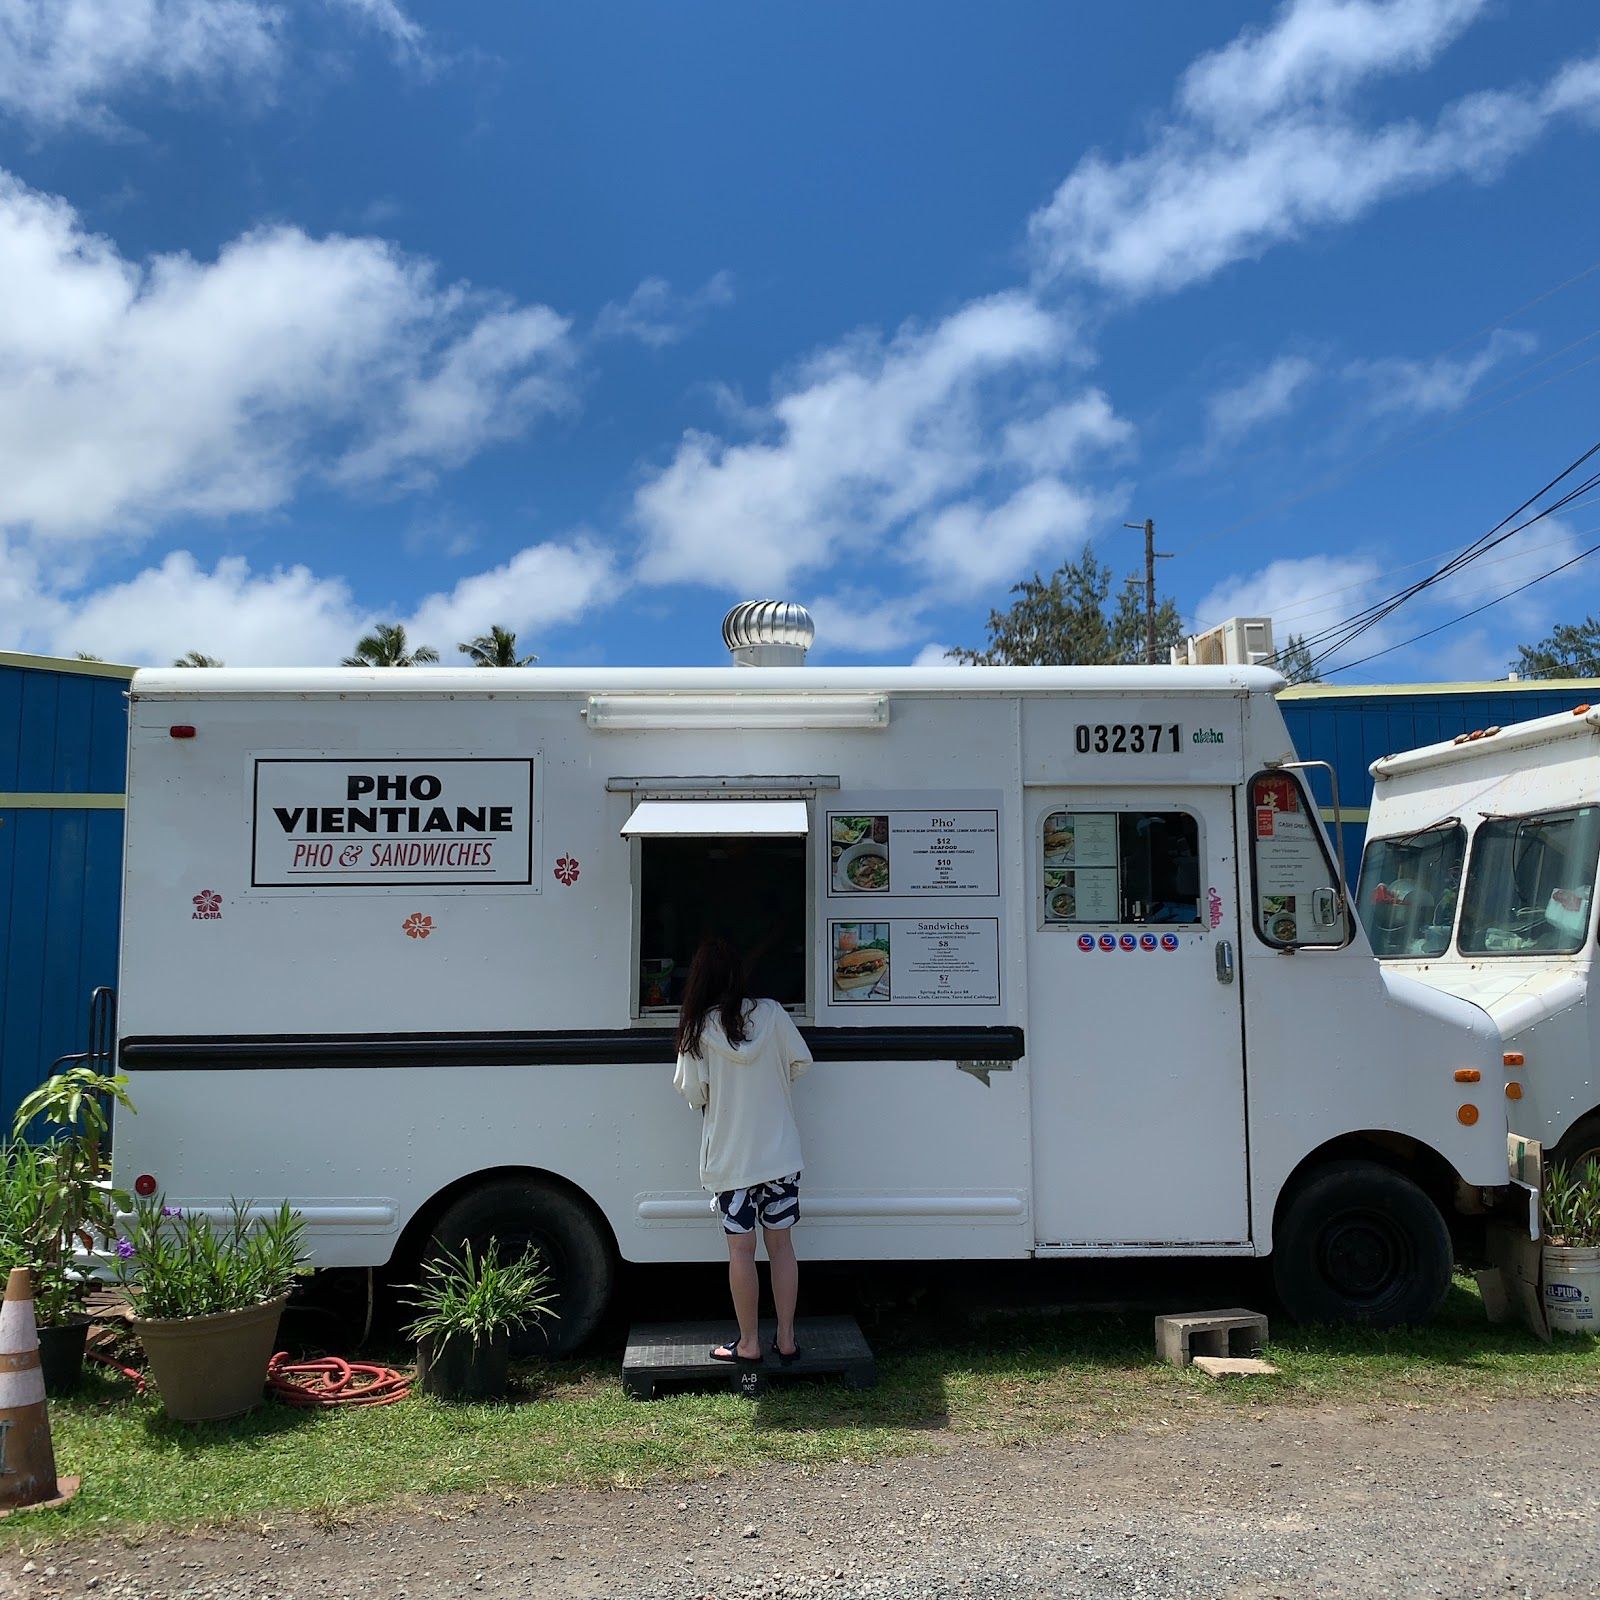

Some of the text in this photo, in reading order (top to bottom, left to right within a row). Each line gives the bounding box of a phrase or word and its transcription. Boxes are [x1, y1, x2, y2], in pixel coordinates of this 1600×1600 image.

[1076, 724, 1180, 753] 032371
[347, 775, 442, 801] PHO
[272, 806, 513, 833] VIENTIANE
[293, 842, 492, 867] PHO & SANDWICHES
[192, 912, 222, 920] ALOHA
[918, 922, 969, 930] Sandwiches
[741, 1373, 758, 1383] A-B
